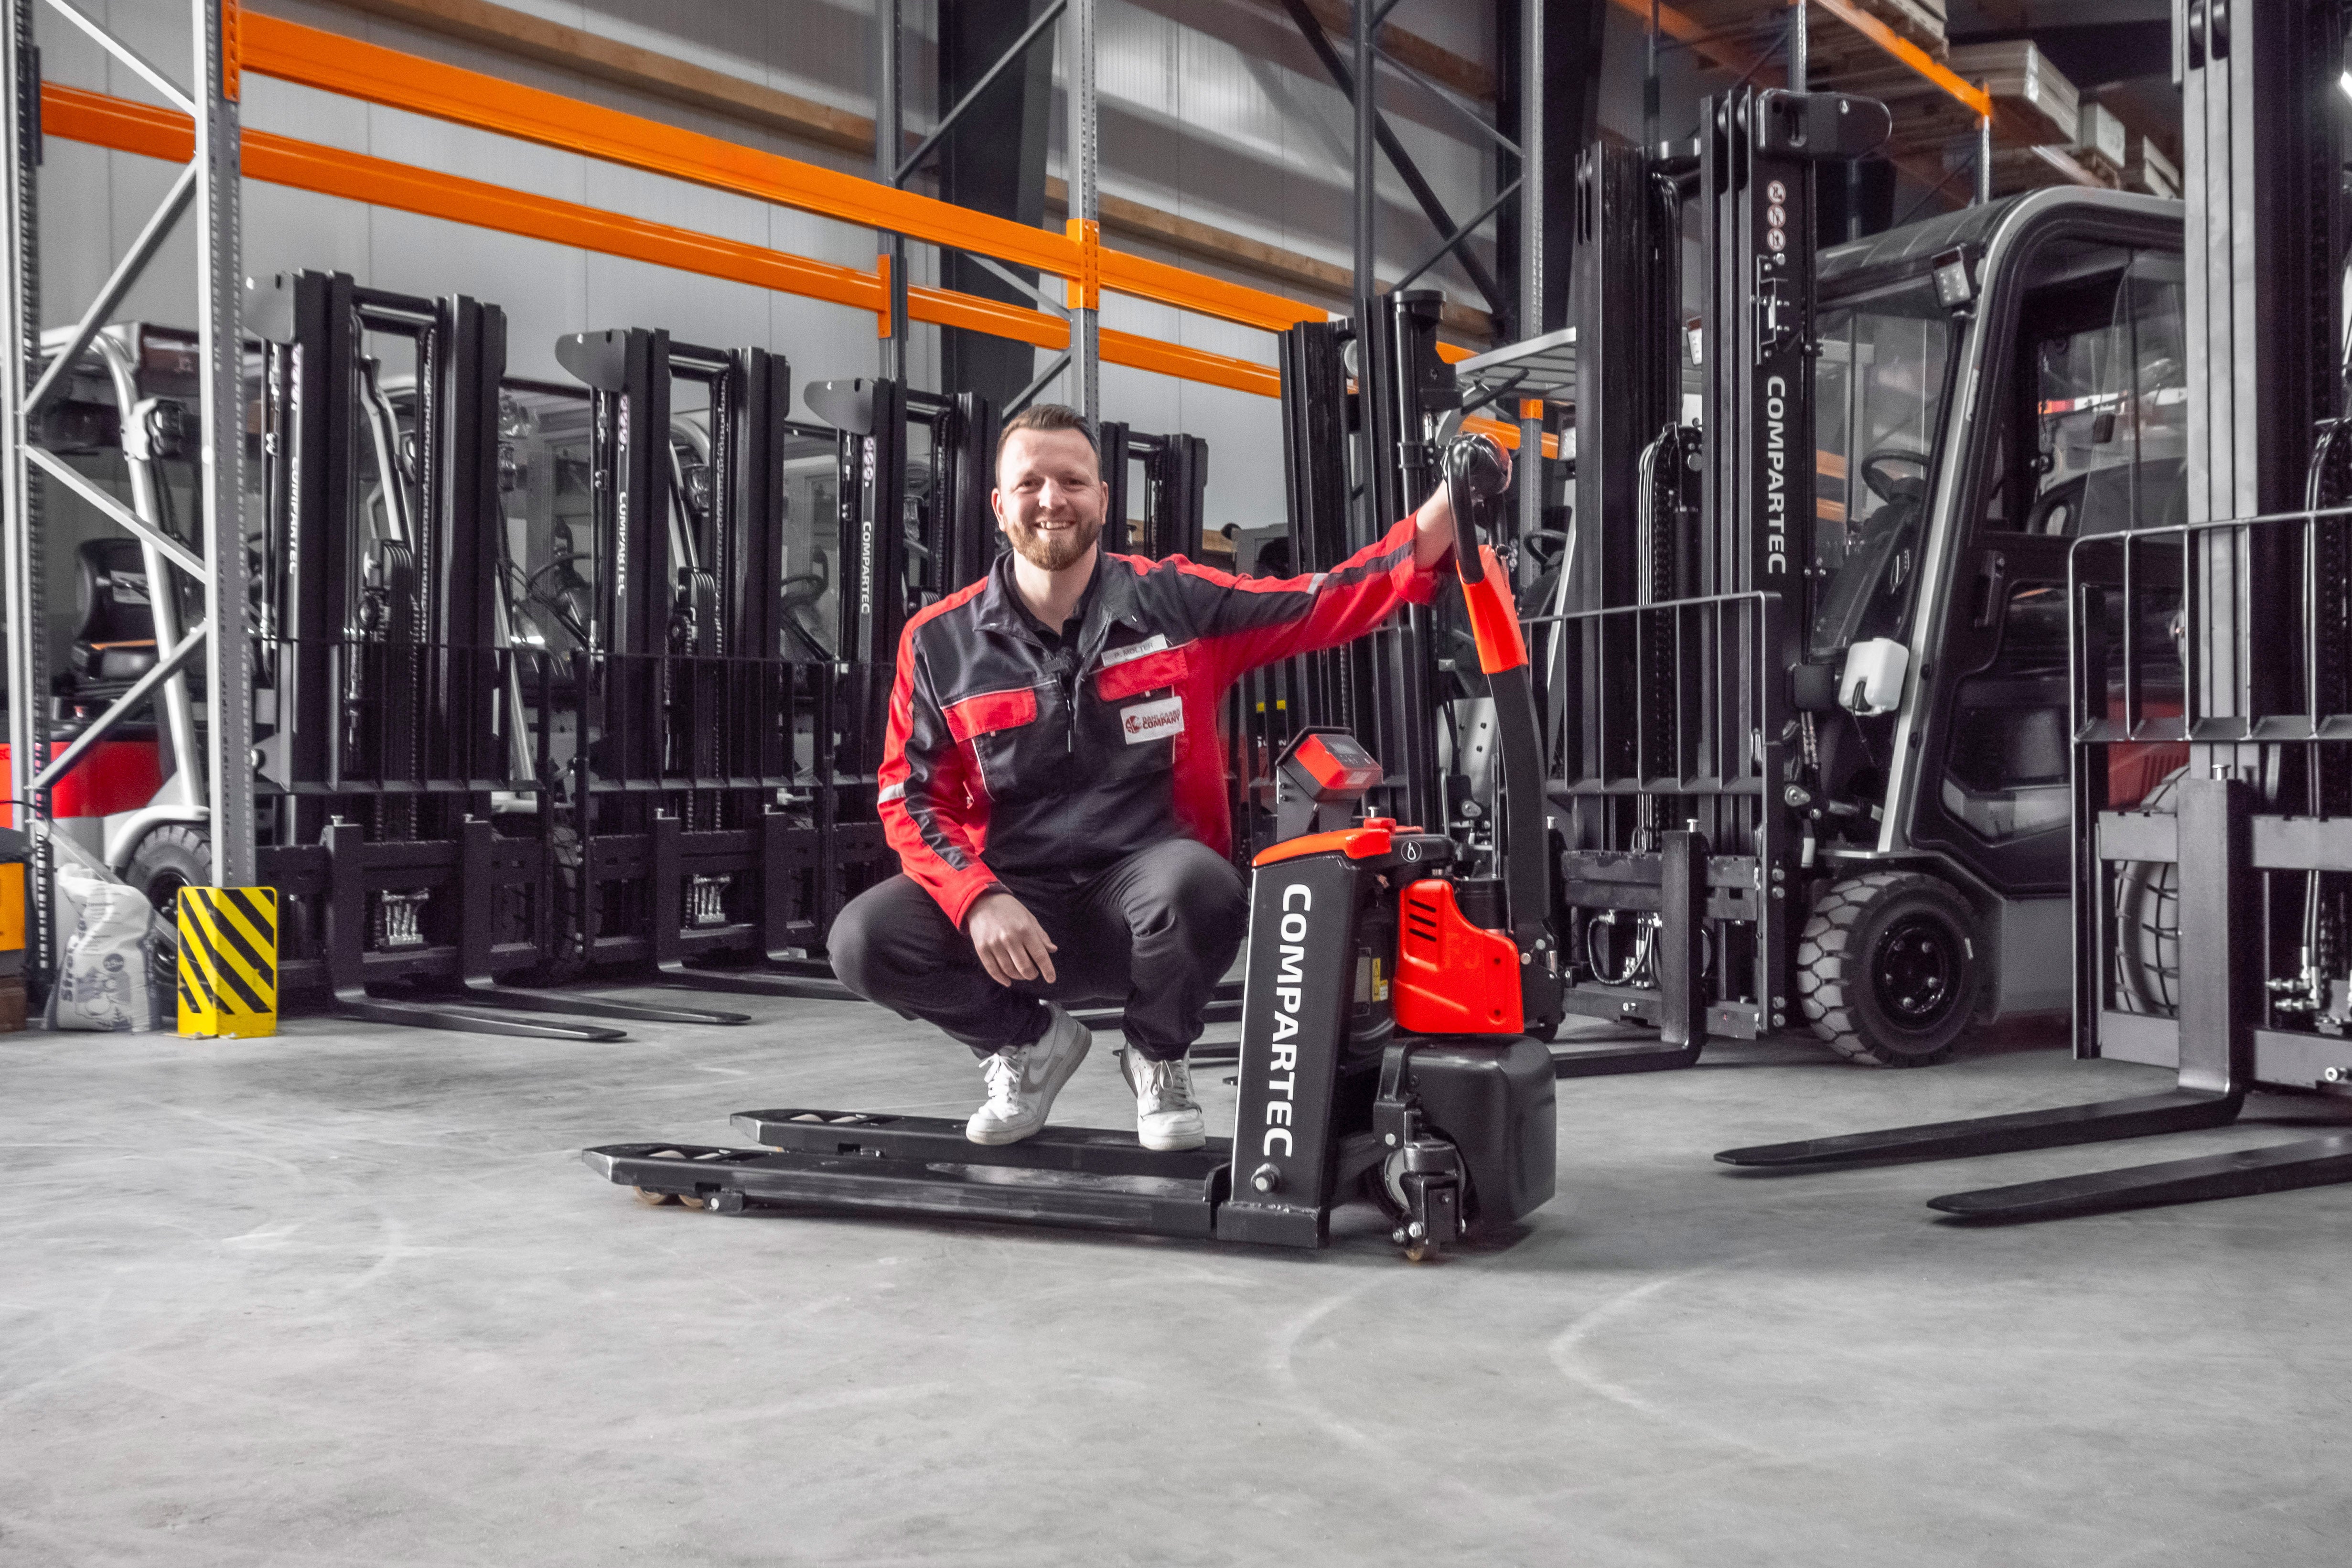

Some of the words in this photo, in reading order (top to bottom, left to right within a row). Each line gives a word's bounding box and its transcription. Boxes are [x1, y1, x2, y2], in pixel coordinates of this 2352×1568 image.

[1767, 375, 1786, 574] COMPARTEC
[861, 521, 871, 613] COMPARTEC
[1124, 643, 1154, 657] MOLTER
[1142, 716, 1180, 730] COMPANY
[1264, 883, 1312, 1157] COMPARTEC
